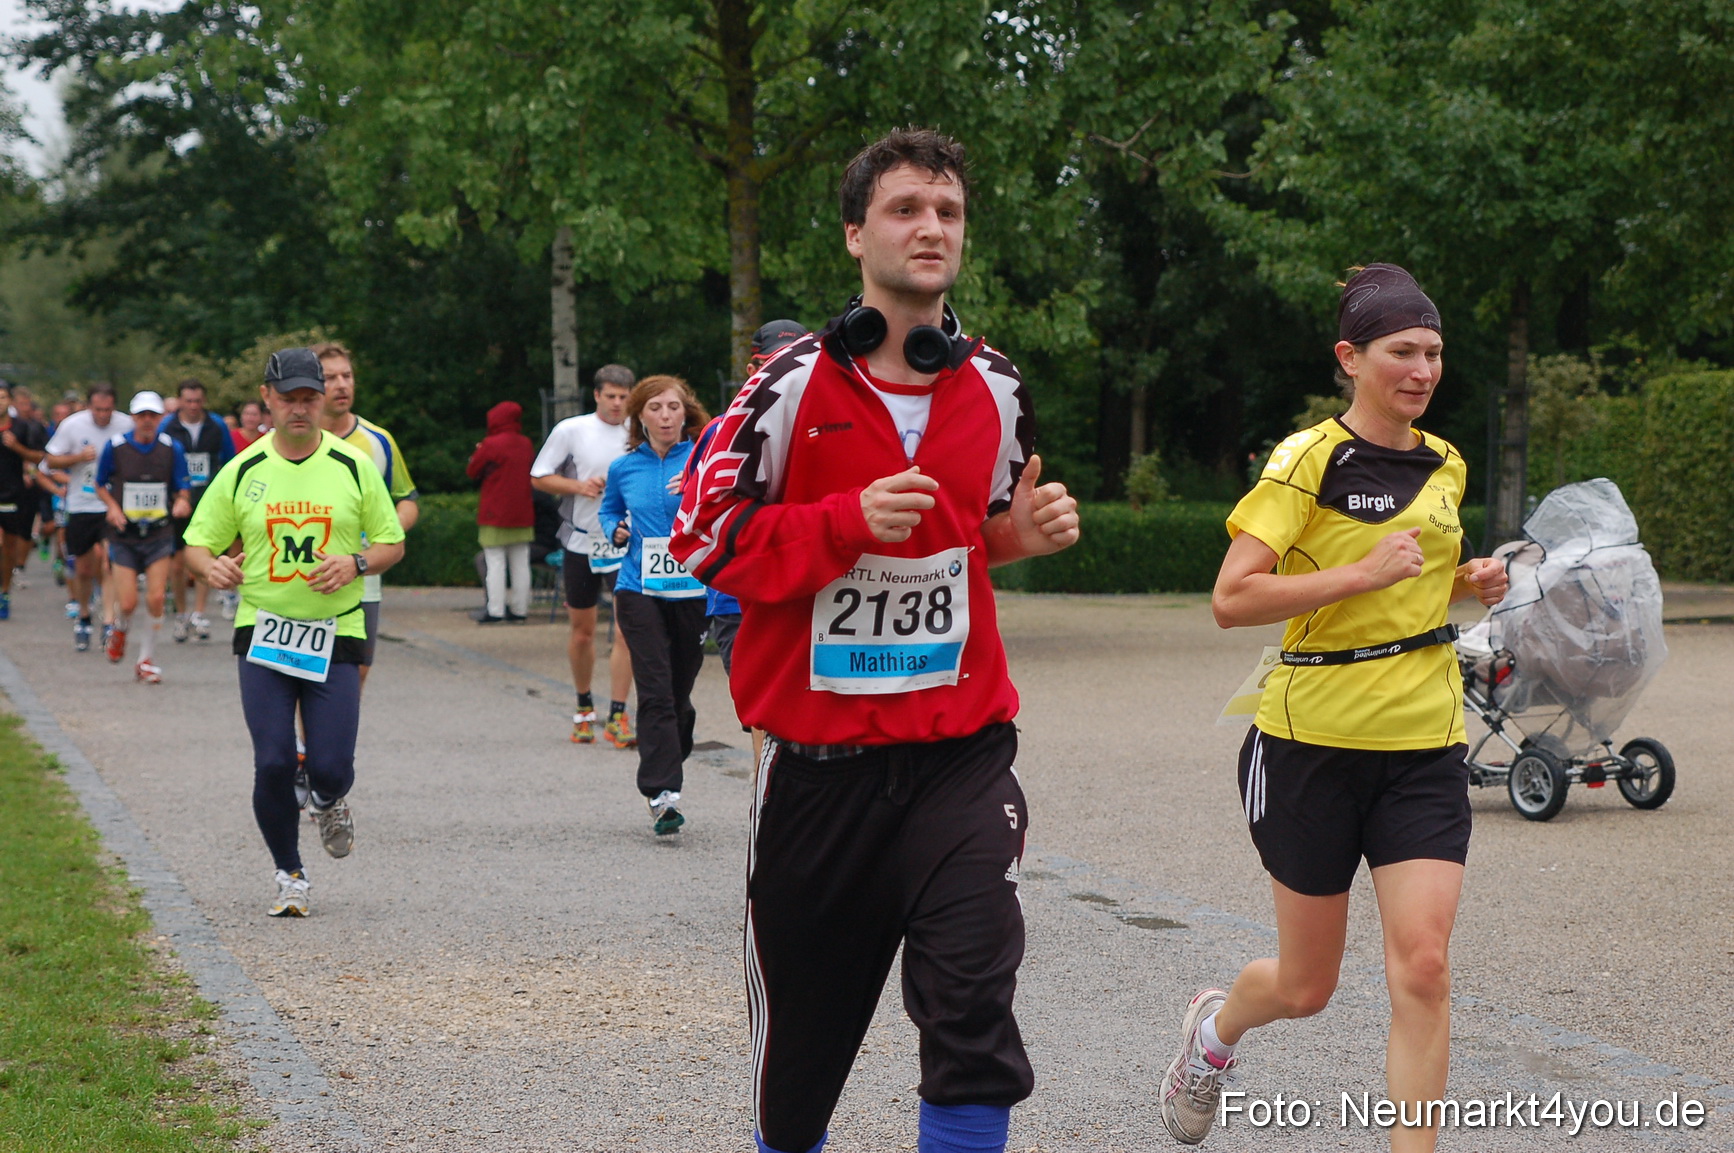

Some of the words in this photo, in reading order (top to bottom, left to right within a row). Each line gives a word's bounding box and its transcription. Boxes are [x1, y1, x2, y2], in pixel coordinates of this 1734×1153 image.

[266, 501, 333, 516] Müller
[1347, 494, 1395, 512] Birgit
[281, 535, 316, 564] M
[840, 568, 876, 582] RTL
[880, 568, 945, 584] Neumarkt
[828, 585, 953, 637] 2138
[262, 618, 327, 652] 2070
[850, 652, 928, 672] Mathias
[1003, 804, 1018, 829] 5
